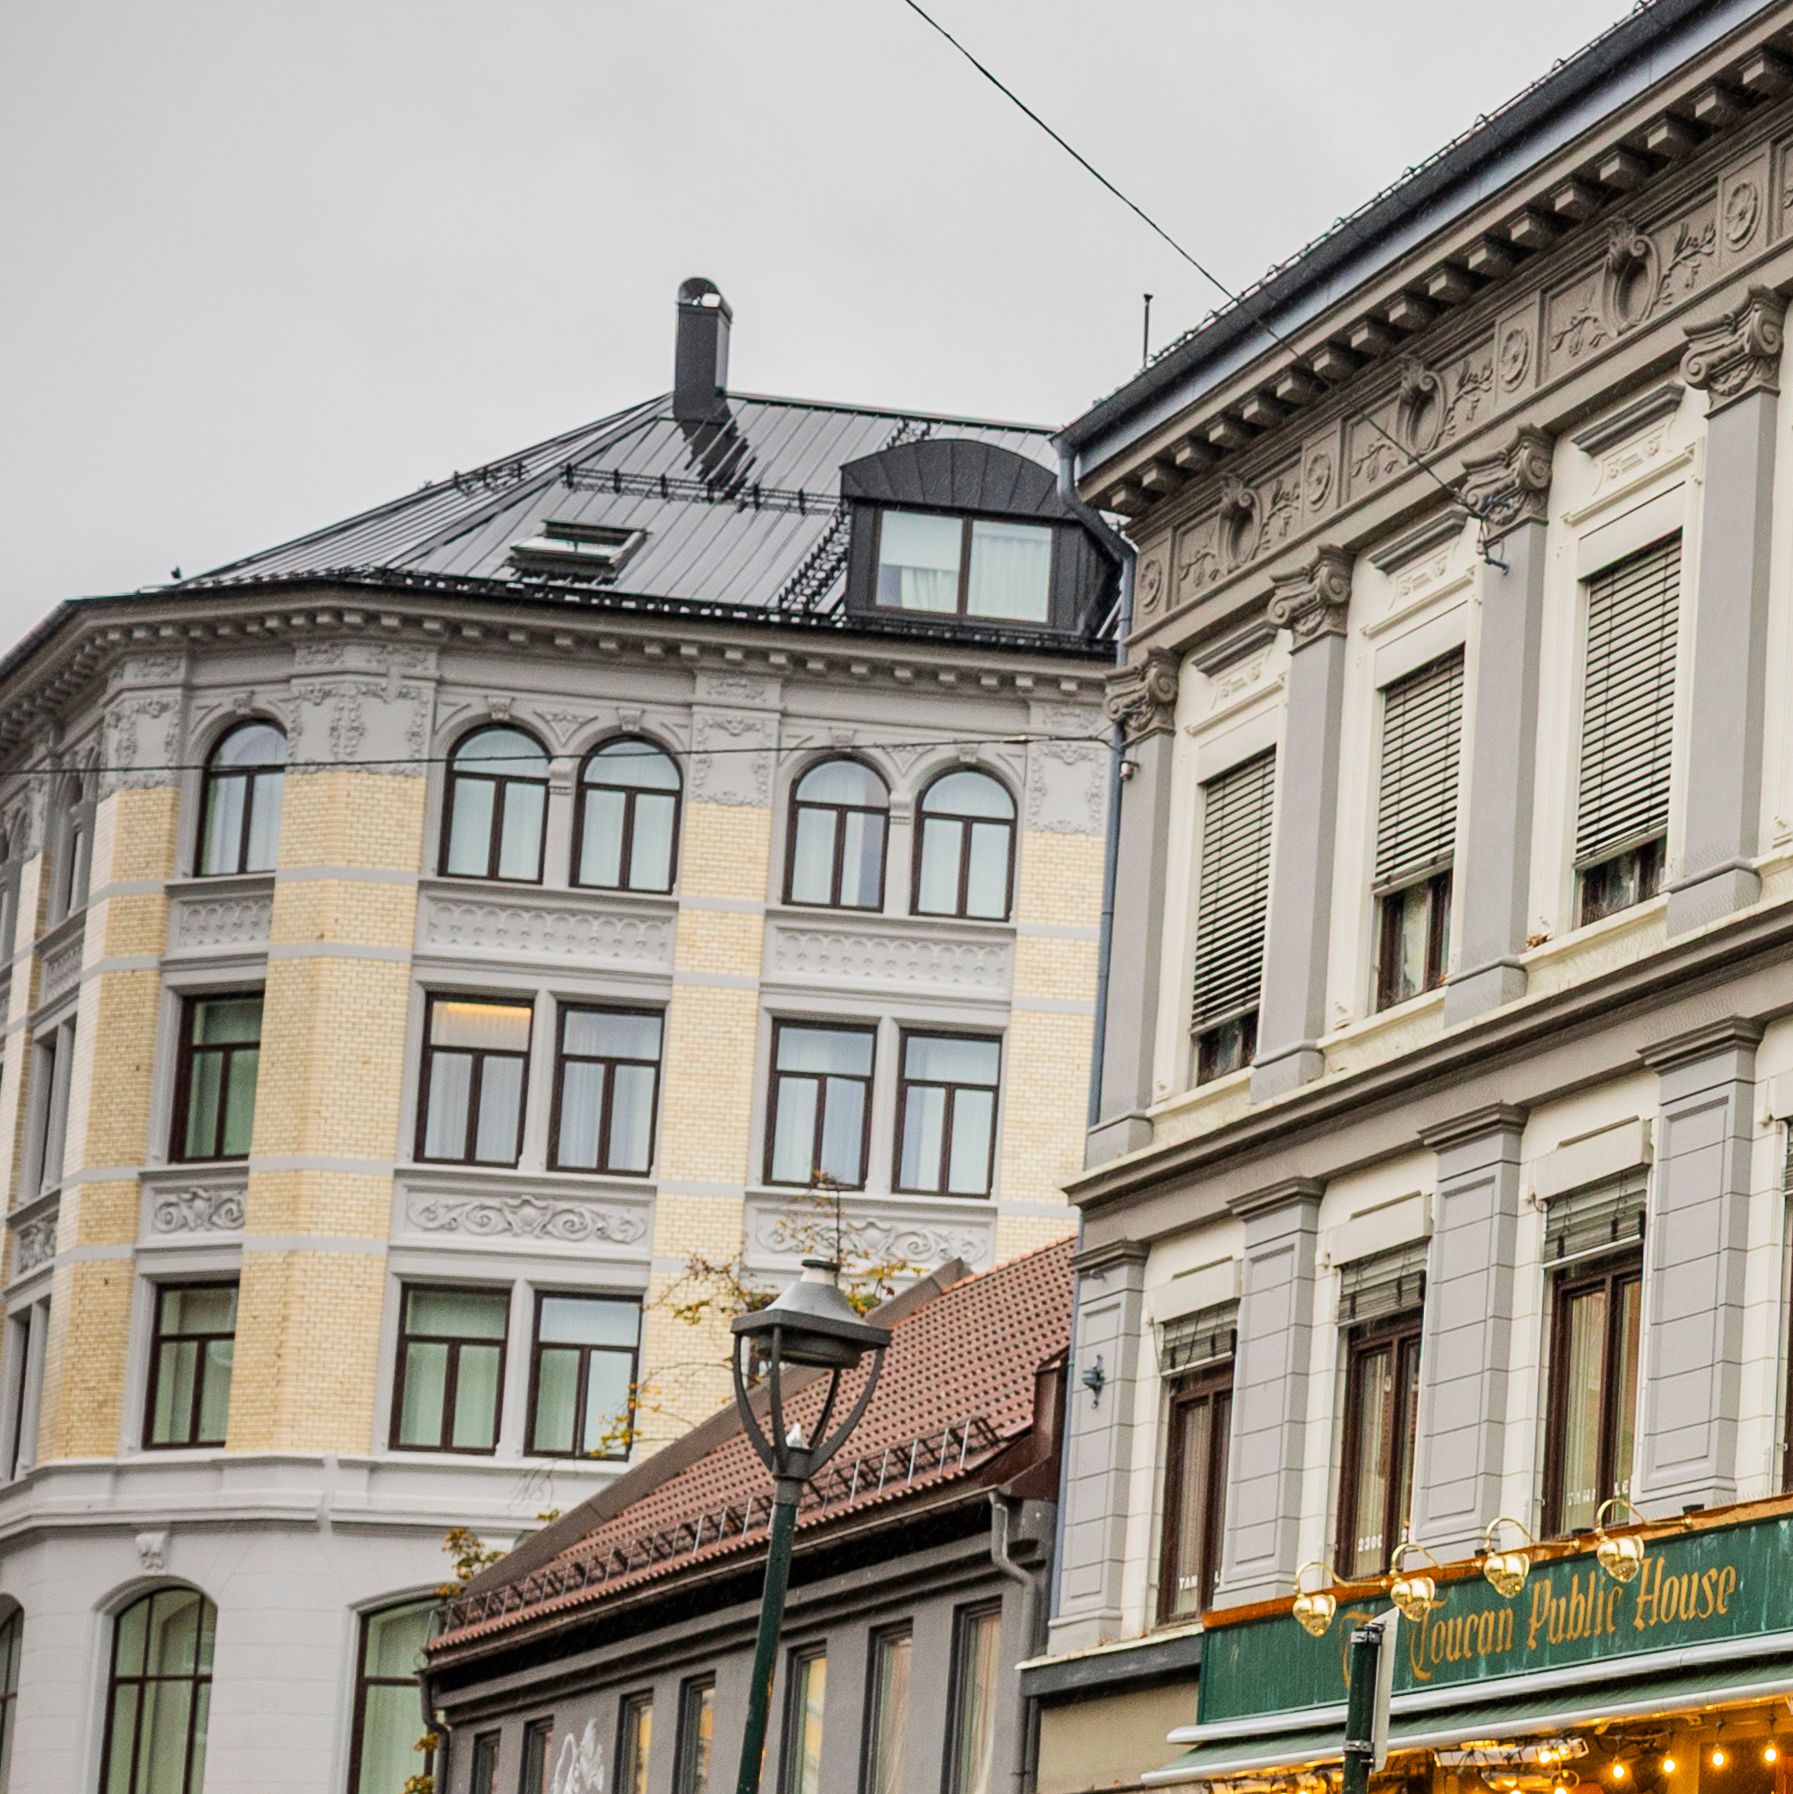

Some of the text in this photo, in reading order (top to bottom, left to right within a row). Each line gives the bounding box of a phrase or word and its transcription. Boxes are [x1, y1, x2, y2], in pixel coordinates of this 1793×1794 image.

[1405, 1599, 1515, 1682] Toucan
[1526, 1570, 1624, 1649] Public
[1632, 1556, 1737, 1631] House
